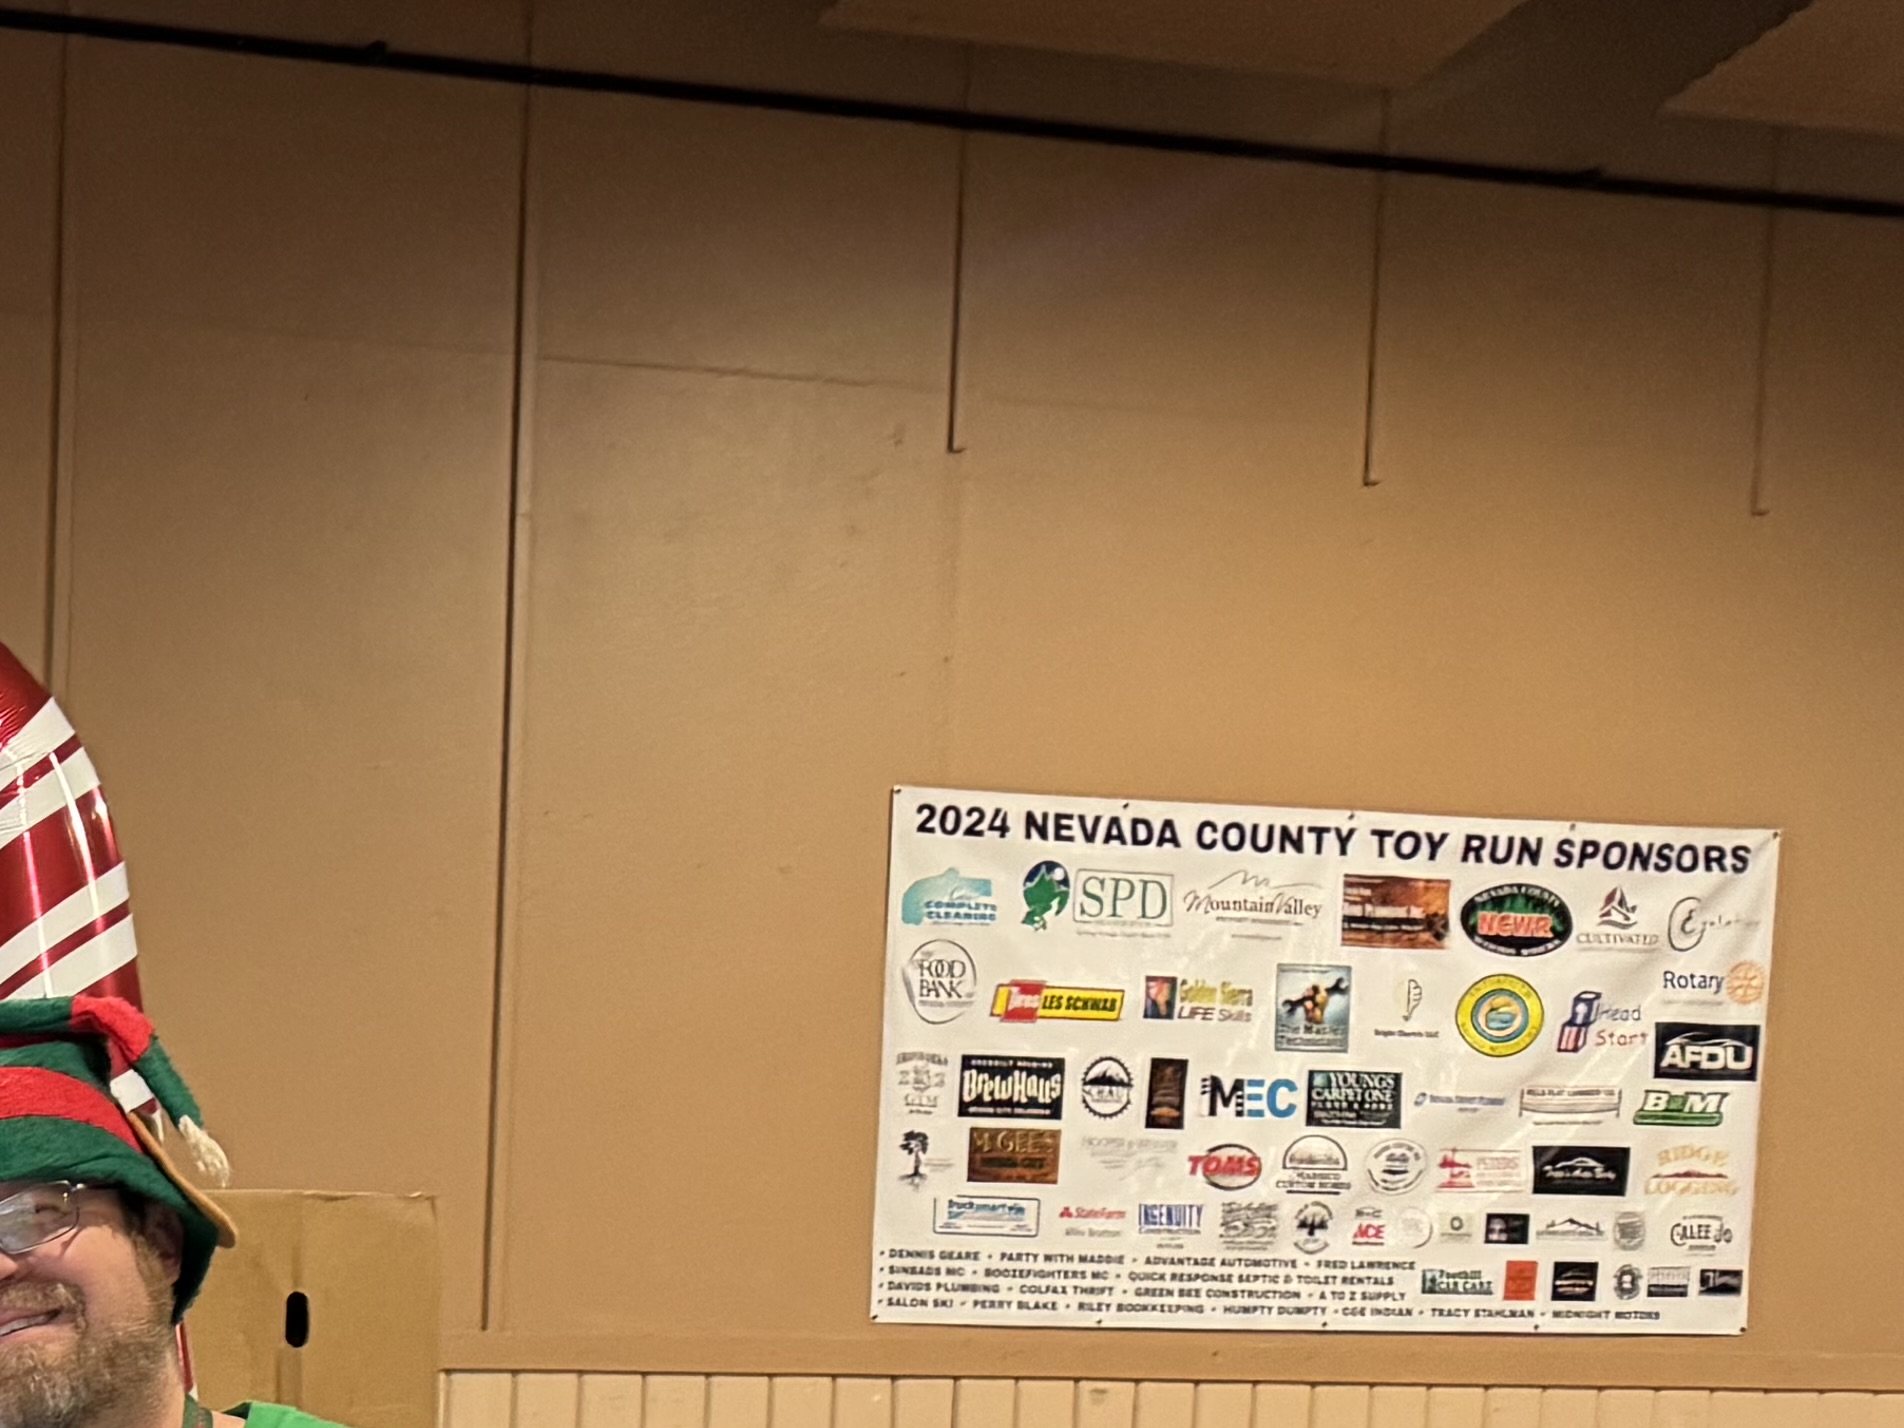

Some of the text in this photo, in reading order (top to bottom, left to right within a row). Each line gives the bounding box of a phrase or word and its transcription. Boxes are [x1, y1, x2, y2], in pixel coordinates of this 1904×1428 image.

[916, 803, 1752, 874] 2024 NEVADA COUNTY TOY RUN SPONSORS
[1079, 875, 1168, 920] SPD
[1576, 932, 1659, 945] CULTIVATED
[1663, 971, 1724, 994] Rotary
[1042, 995, 1117, 1012] LES SCHWAB
[1594, 1030, 1648, 1046] Start
[1660, 1045, 1752, 1070] AFDU
[1329, 1072, 1395, 1088] YOUNGS
[1201, 1075, 1298, 1118] MEC
[1311, 1088, 1362, 1101] CARPET
[1188, 1156, 1262, 1177] TOMS
[1000, 1253, 1040, 1263] PARTY
[1043, 1254, 1074, 1263] WITH
[1144, 1256, 1215, 1266] ADVANTAGE
[1220, 1258, 1297, 1269] AUTOMOTIVE
[1316, 1260, 1348, 1269] FRED
[1350, 1260, 1416, 1270] LAWRENCE
[1128, 1272, 1166, 1282] QUICK
[1170, 1273, 1233, 1283] RESPONSE
[1237, 1274, 1280, 1284] SEPTIC
[1296, 1275, 1338, 1285] TOILET
[1341, 1276, 1394, 1286] RENTALS
[935, 1282, 1000, 1293] PLUMBING
[1019, 1284, 1068, 1295] COLFAX
[1134, 1287, 1174, 1298] GREEN
[1205, 1289, 1301, 1300] CONSTRUCTION
[1360, 1291, 1406, 1301] SUPPLY
[1116, 1303, 1204, 1314] BOOKKEEPING
[1223, 1304, 1274, 1315] HUMPTY
[1431, 1308, 1470, 1318] TRACY
